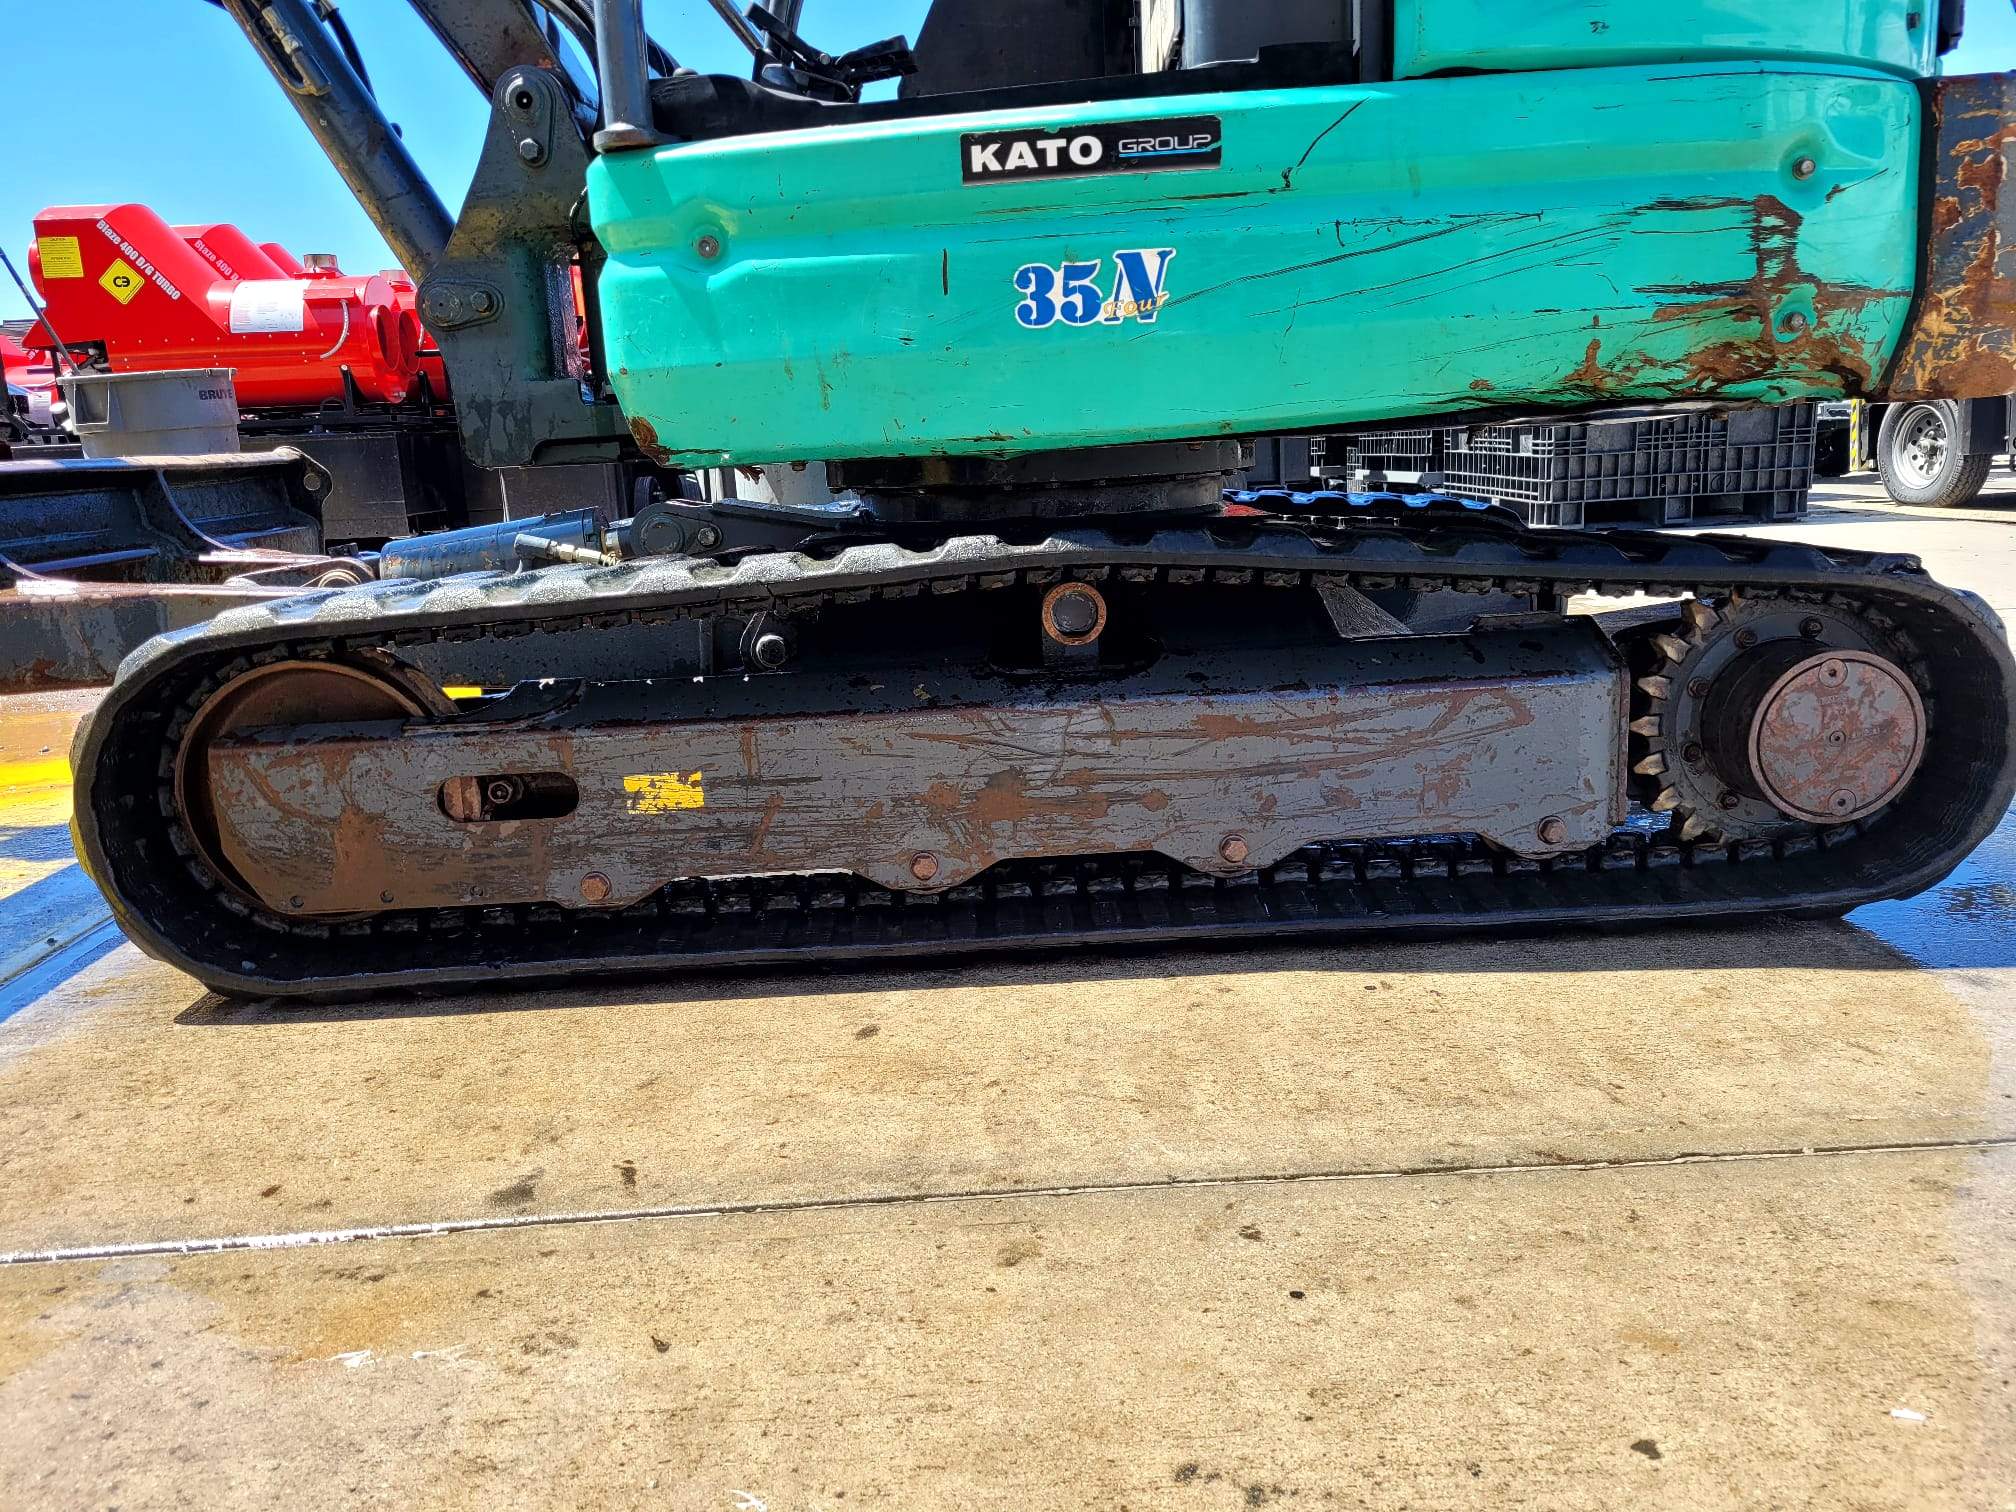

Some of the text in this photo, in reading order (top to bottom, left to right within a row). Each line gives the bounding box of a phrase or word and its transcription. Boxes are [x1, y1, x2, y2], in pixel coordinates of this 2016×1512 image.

[970, 134, 1212, 173] KATO GROUP
[96, 219, 181, 300] Blaze 400 D/G TURBO
[1103, 291, 1170, 319] Four
